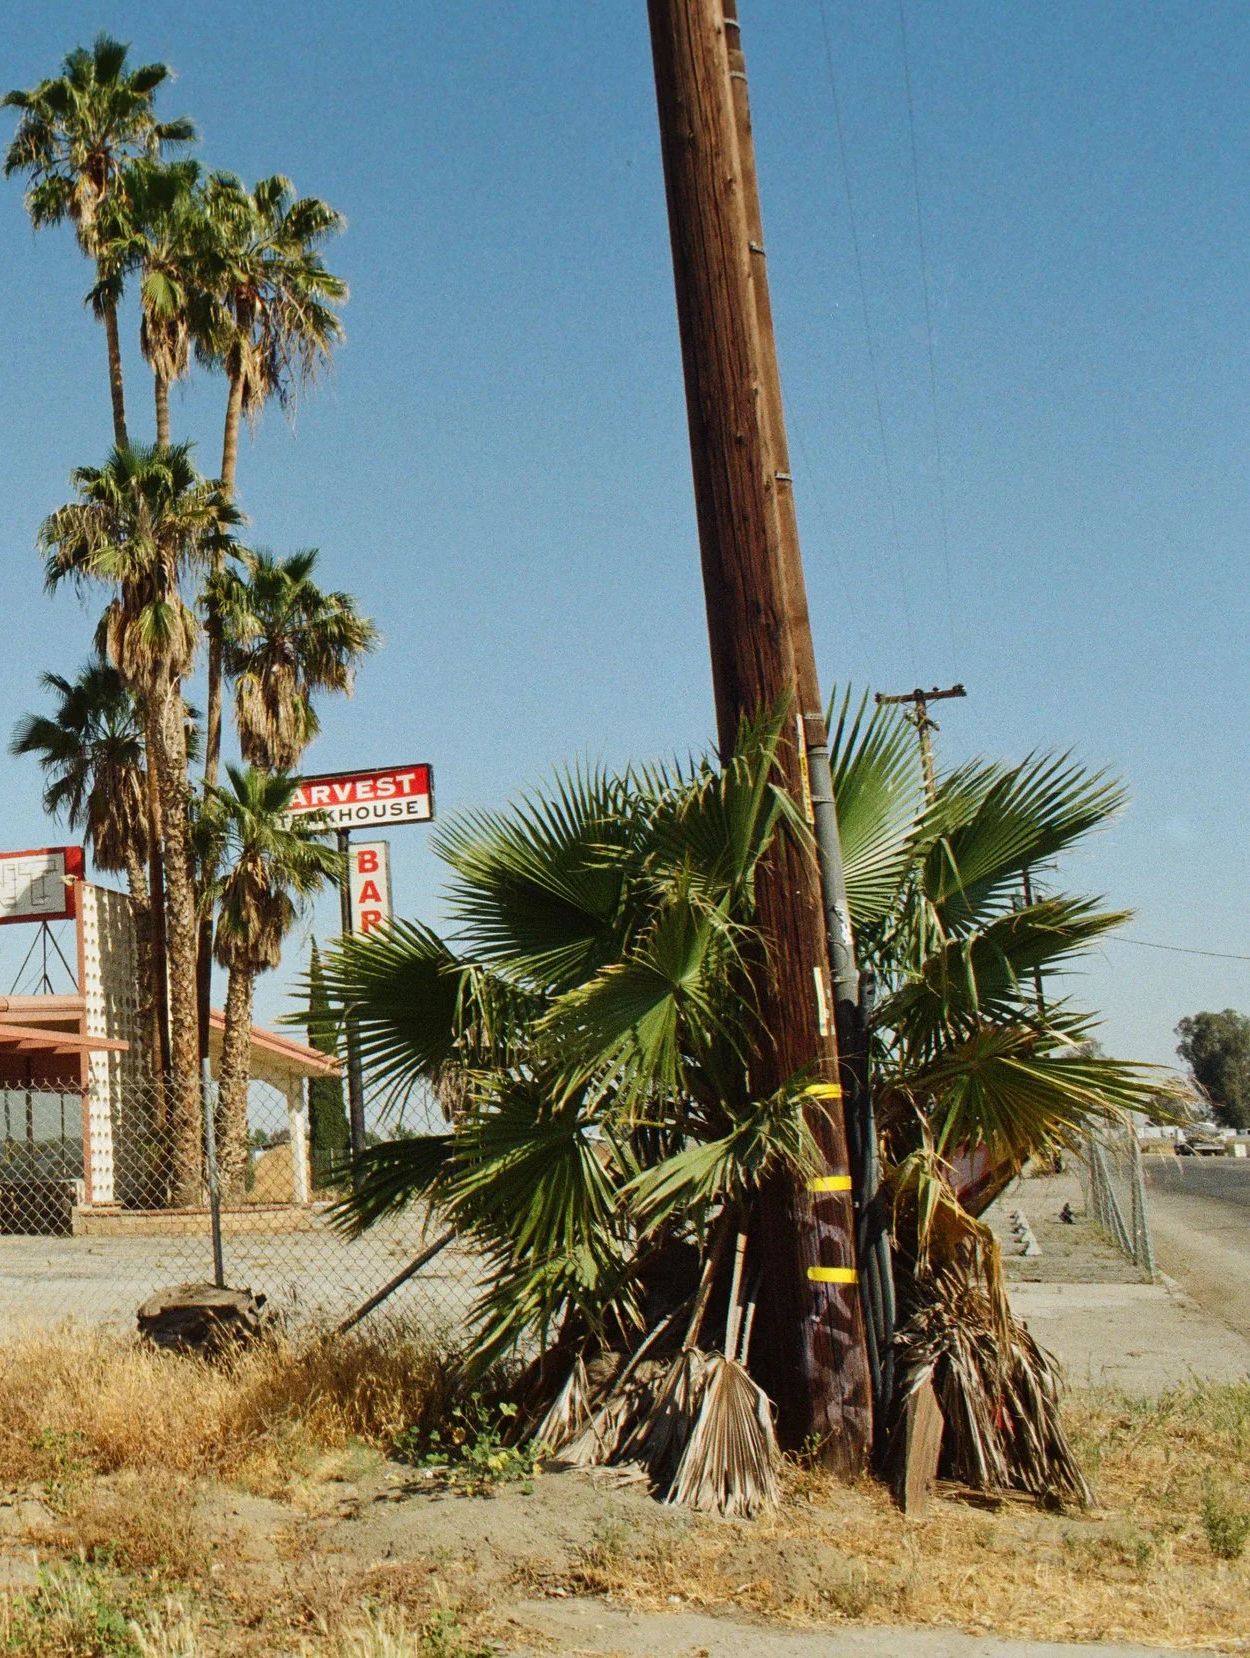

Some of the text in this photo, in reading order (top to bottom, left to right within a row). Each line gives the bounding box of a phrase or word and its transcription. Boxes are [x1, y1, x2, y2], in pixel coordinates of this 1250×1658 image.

[289, 772, 415, 807] ARVEST
[278, 801, 418, 829] TEKHOUSE
[356, 849, 383, 935] BAR
